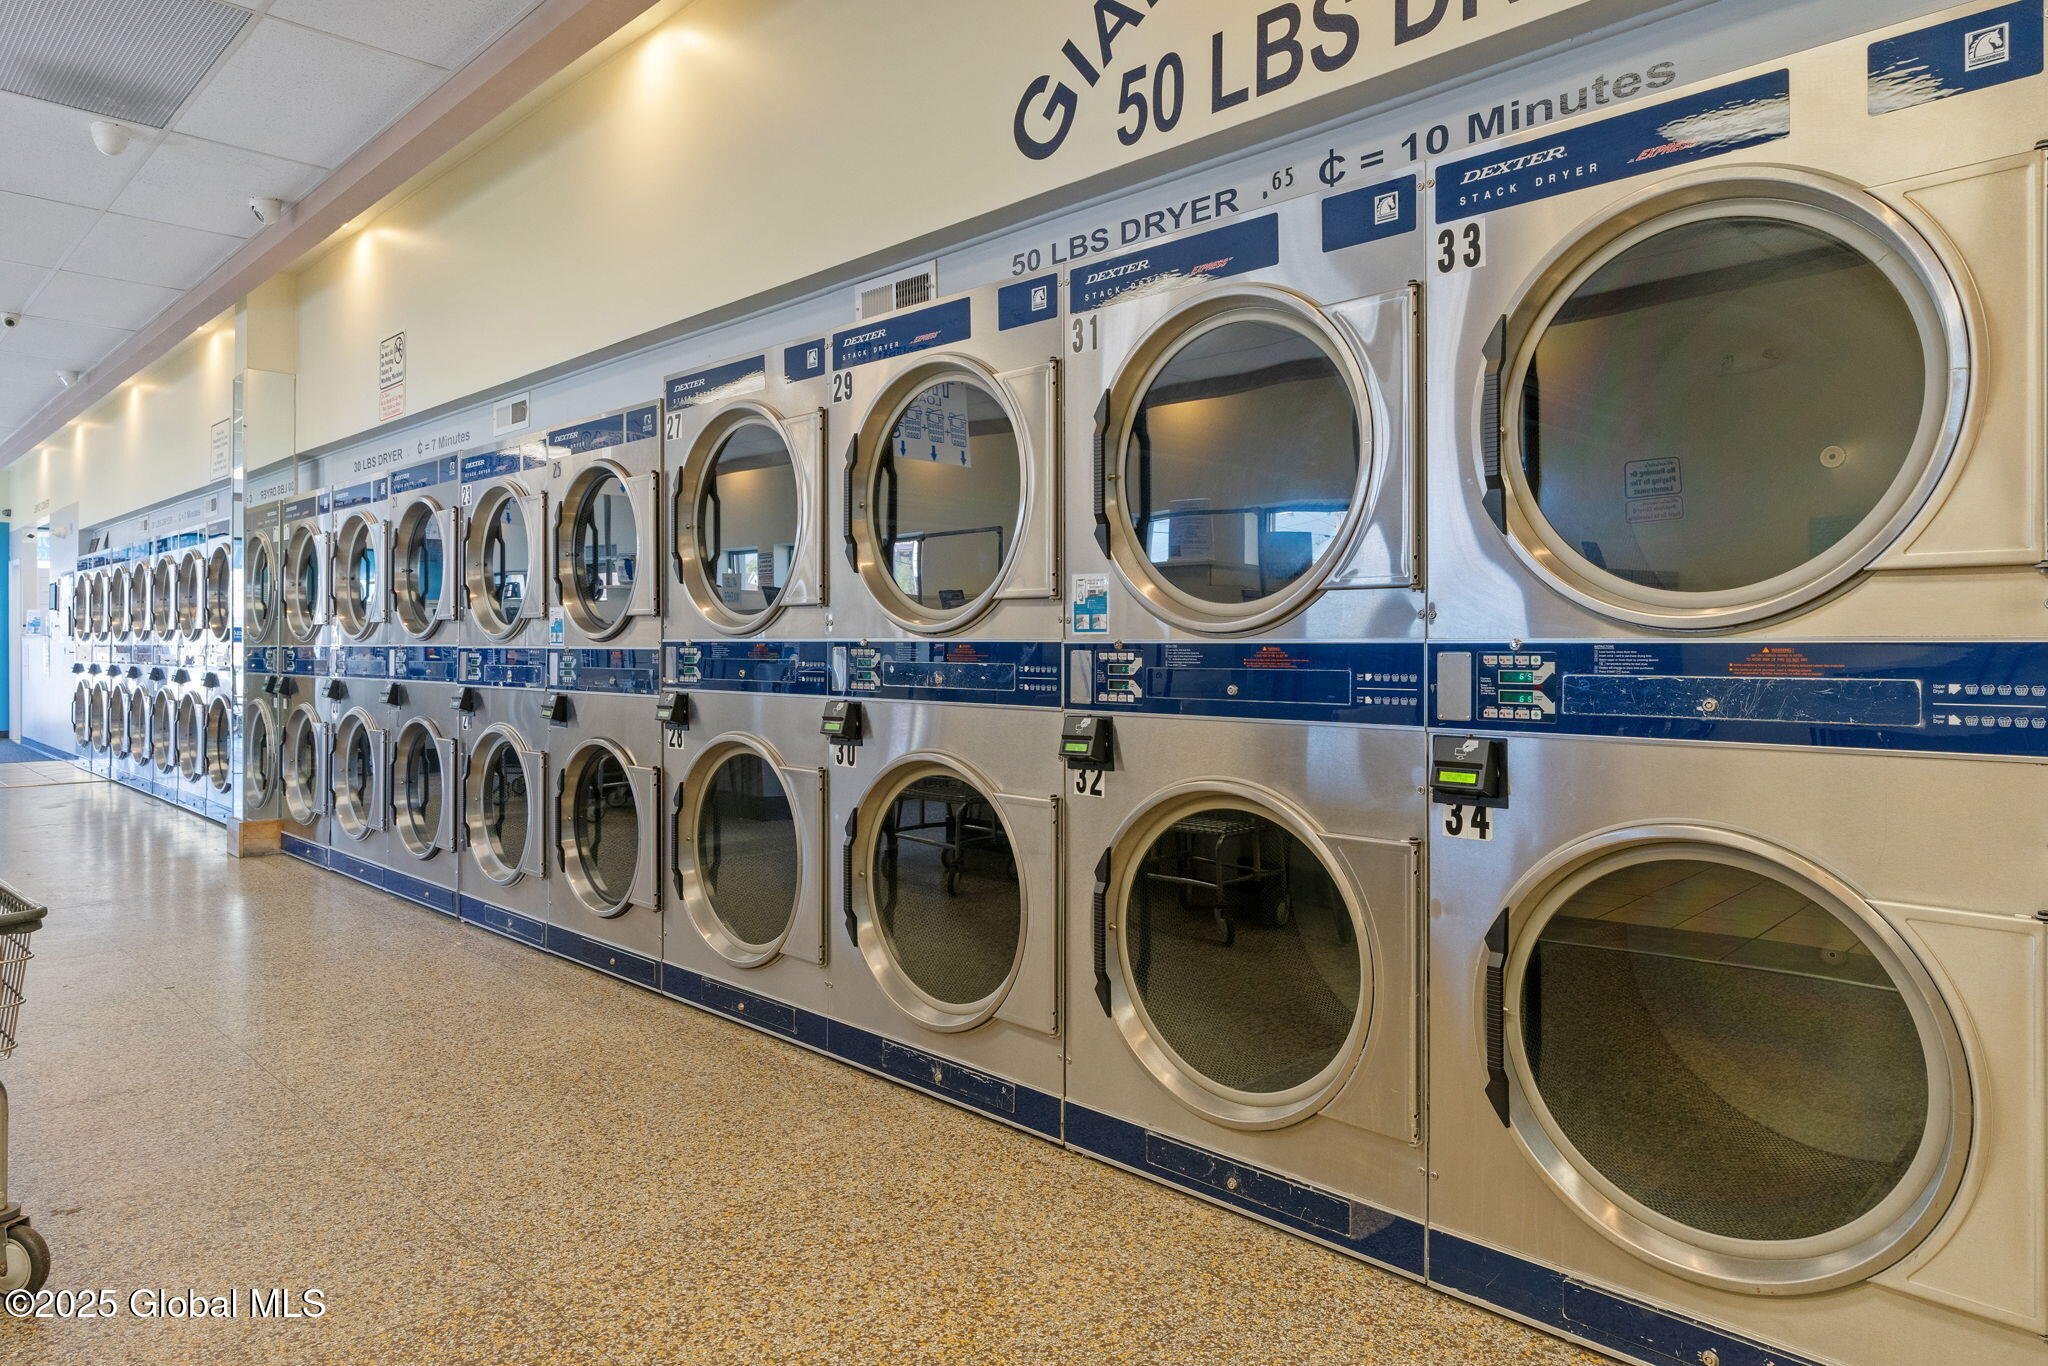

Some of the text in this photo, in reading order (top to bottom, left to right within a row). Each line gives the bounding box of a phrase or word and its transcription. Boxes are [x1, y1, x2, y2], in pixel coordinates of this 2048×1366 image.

[1117, 52, 1184, 146] 50
[1212, 0, 1360, 114] LBS
[1012, 248, 1041, 276] 50
[1051, 227, 1109, 265] LBS
[1120, 188, 1240, 245] DRYER
[1318, 149, 1346, 187] ¢
[1401, 124, 1449, 162] 10
[1467, 60, 1676, 143] Minutes
[1459, 145, 1568, 185] DEXTER
[1459, 162, 1598, 206] STACK DRYER
[1437, 222, 1481, 273] 33
[1085, 259, 1150, 285] DEXTER
[1085, 286, 1120, 301] STACK
[842, 328, 887, 348] DEXTER
[1072, 315, 1098, 353] 31
[842, 341, 899, 361] STACK DRYER
[674, 378, 705, 393] DEXTER
[833, 371, 852, 403] 29
[554, 431, 578, 443] DEXTER
[667, 413, 681, 440] 27
[353, 461, 361, 473] 30
[362, 456, 377, 470] LBS
[378, 448, 403, 466] DRYER
[438, 431, 471, 449] Minutes
[552, 461, 561, 478] 25
[669, 729, 683, 748] 28
[836, 745, 855, 766] 30
[1076, 769, 1103, 797] 32
[1445, 803, 1490, 840] 34
